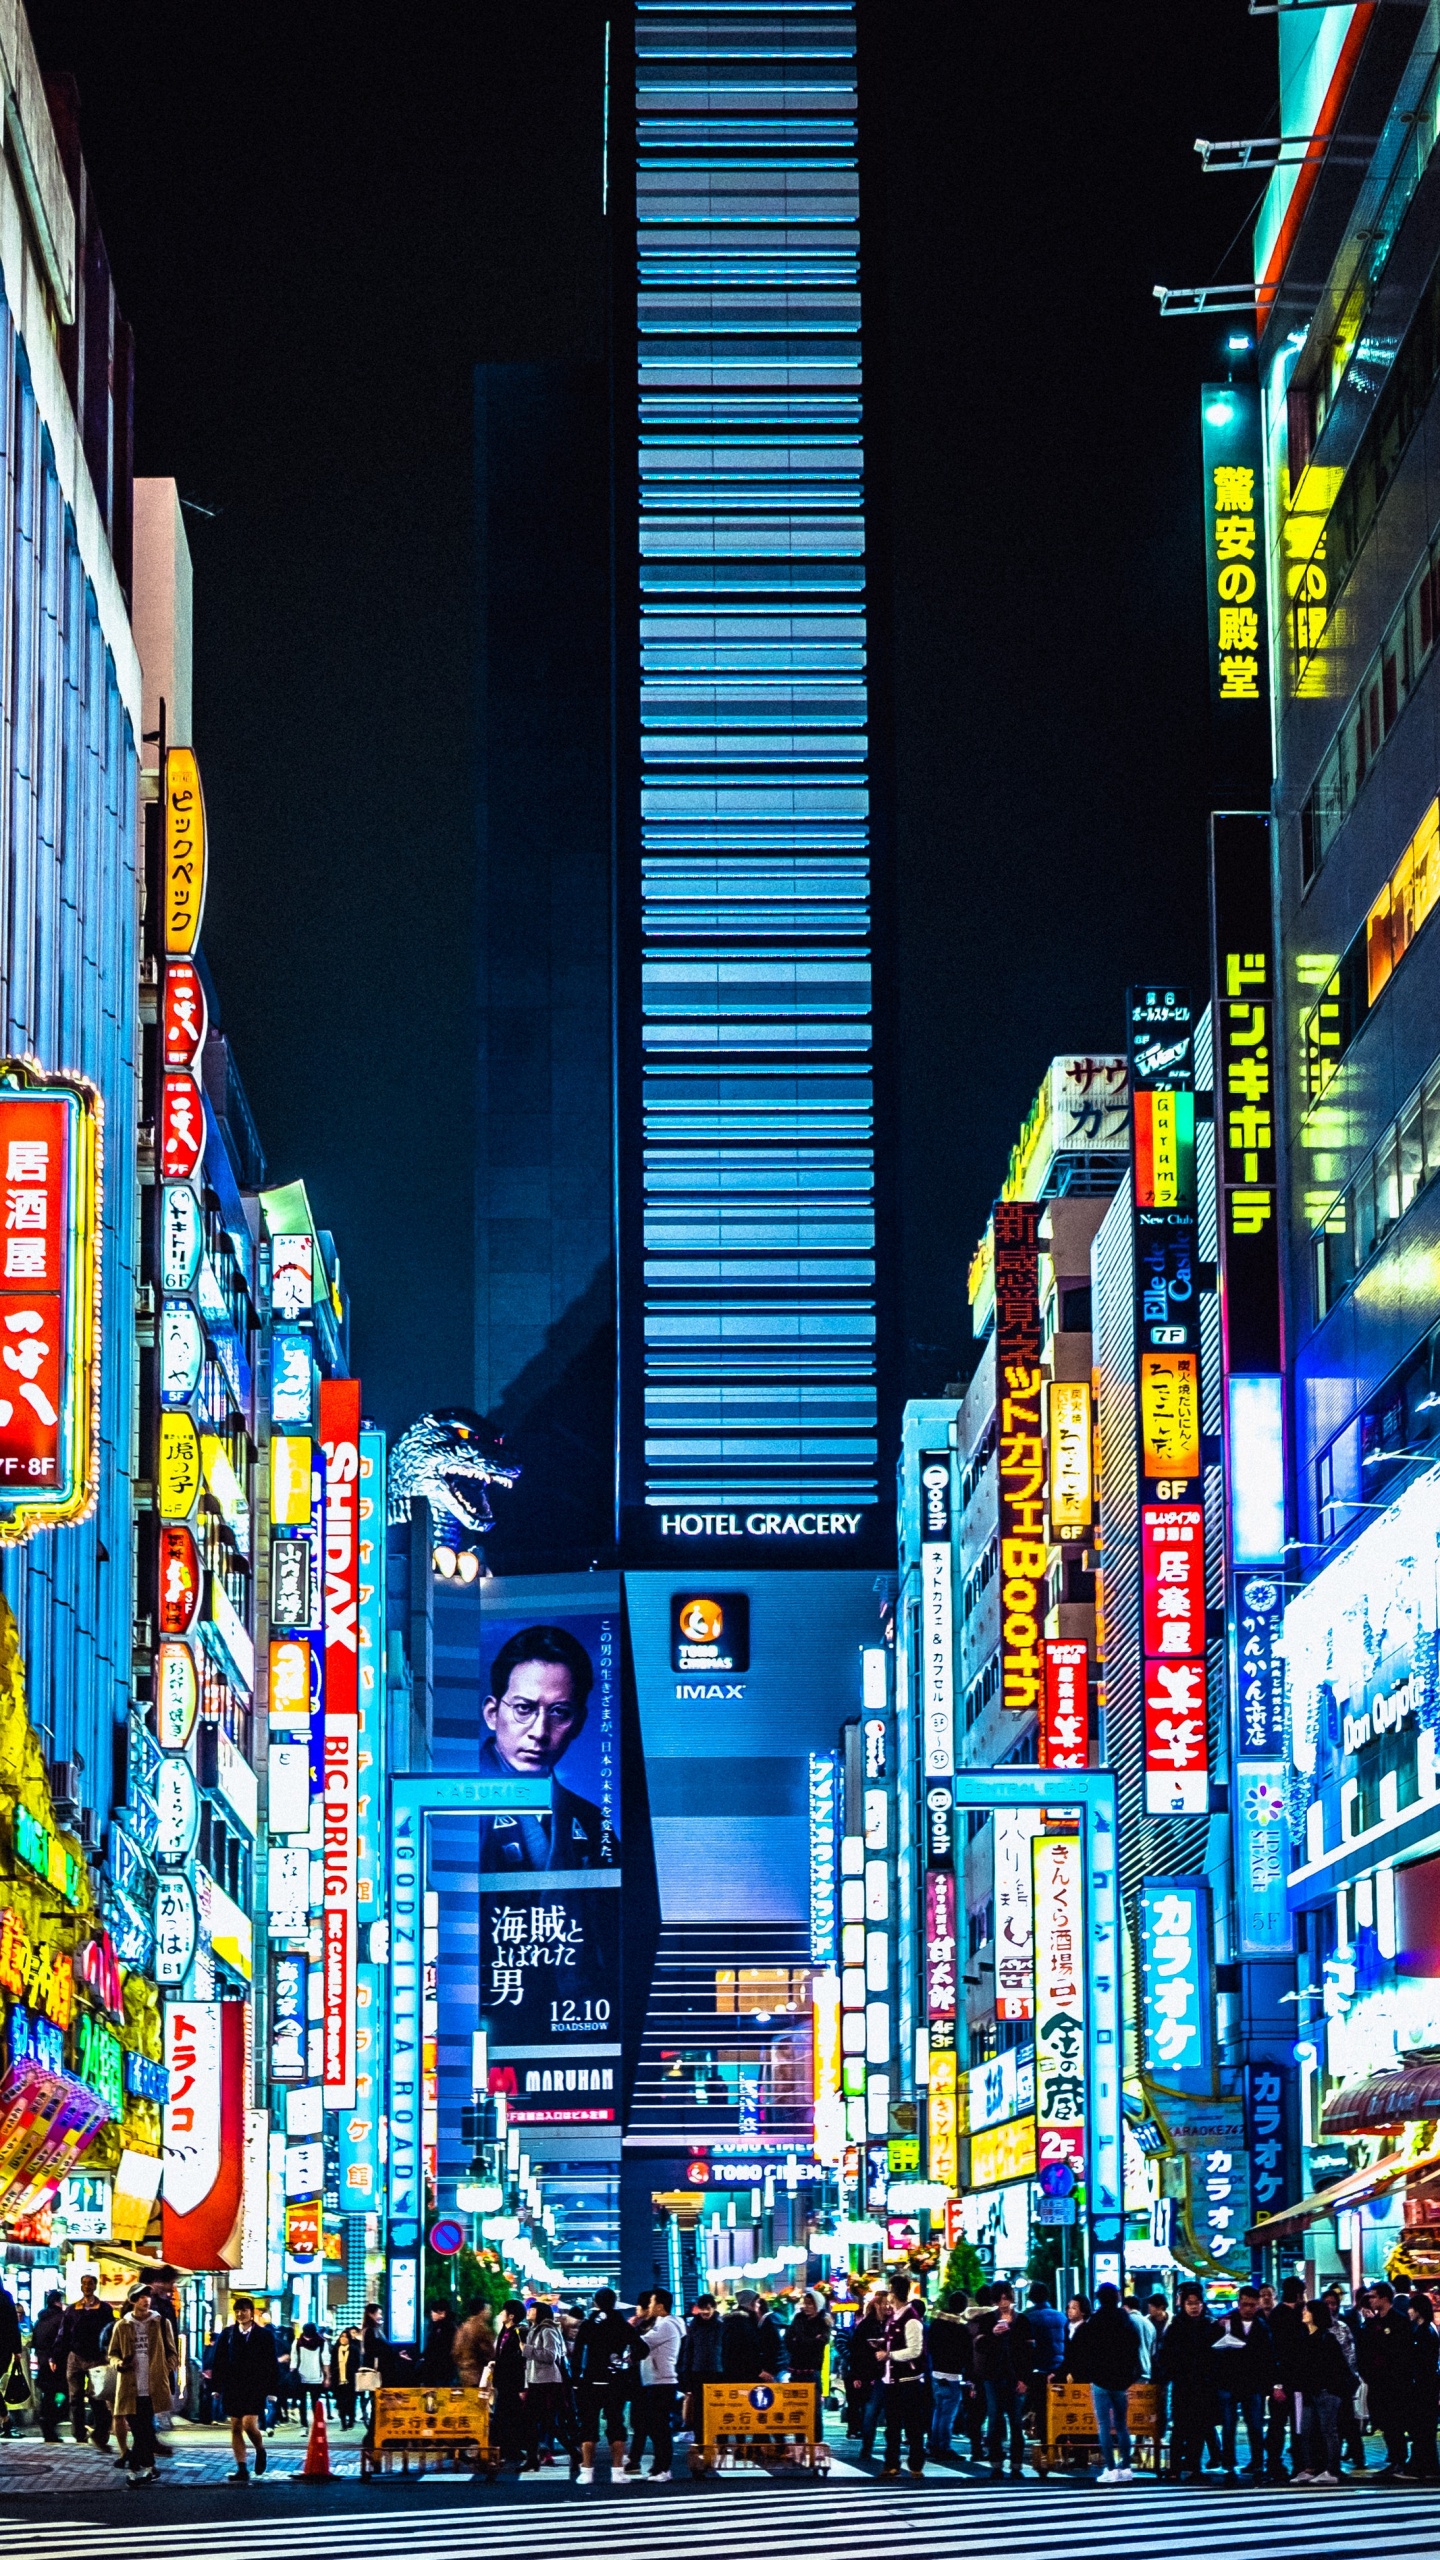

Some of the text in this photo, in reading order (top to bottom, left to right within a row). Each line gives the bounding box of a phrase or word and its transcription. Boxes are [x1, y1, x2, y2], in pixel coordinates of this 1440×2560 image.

[1213, 465, 1259, 699] 驚安の殿堂
[1226, 953, 1271, 1234] ドン・キホーテ
[4, 1140, 49, 1278] 居酒屋
[1139, 1214, 1194, 1226] New Club
[1167, 1230, 1193, 1301] Castle
[165, 1273, 191, 1288] 6F
[1143, 1275, 1168, 1322] Elle
[1154, 1329, 1182, 1341] 7F
[168, 1391, 185, 1401] 5F
[1155, 1480, 1188, 1500] 6F
[661, 1512, 863, 1536] HOTEL GRACERY
[1060, 1525, 1084, 1540] 6F
[321, 1441, 359, 1653] SHIDAX
[675, 1684, 744, 1700] IMAX
[1343, 1712, 1371, 1757] Don
[324, 1735, 348, 1898] BIC DRUG
[163, 1852, 182, 1864] 1F
[1050, 1844, 1073, 1976] きんくら酒場
[1252, 1912, 1281, 1932] 5F
[490, 1904, 585, 1945] 海賊と
[162, 1962, 182, 1976] B1
[490, 1943, 577, 1969] よばれた
[489, 1968, 525, 2006] 男
[1152, 1894, 1197, 2061] カラオケ
[394, 1846, 416, 2180] GODZILLA ROAD
[550, 1998, 612, 2023] 12.10
[550, 2021, 609, 2032] ROADSHOW
[931, 2020, 955, 2034] 4F
[931, 2034, 955, 2048] 3F
[171, 2014, 197, 2133] トラノコ
[1040, 2011, 1084, 2120] 金の蔵
[525, 2069, 614, 2092] MARUHAN
[1040, 2130, 1076, 2160] 2F
[1253, 2071, 1285, 2203] カラオケ
[711, 2164, 763, 2181] TOHO
[1206, 2149, 1237, 2258] カラオケ
